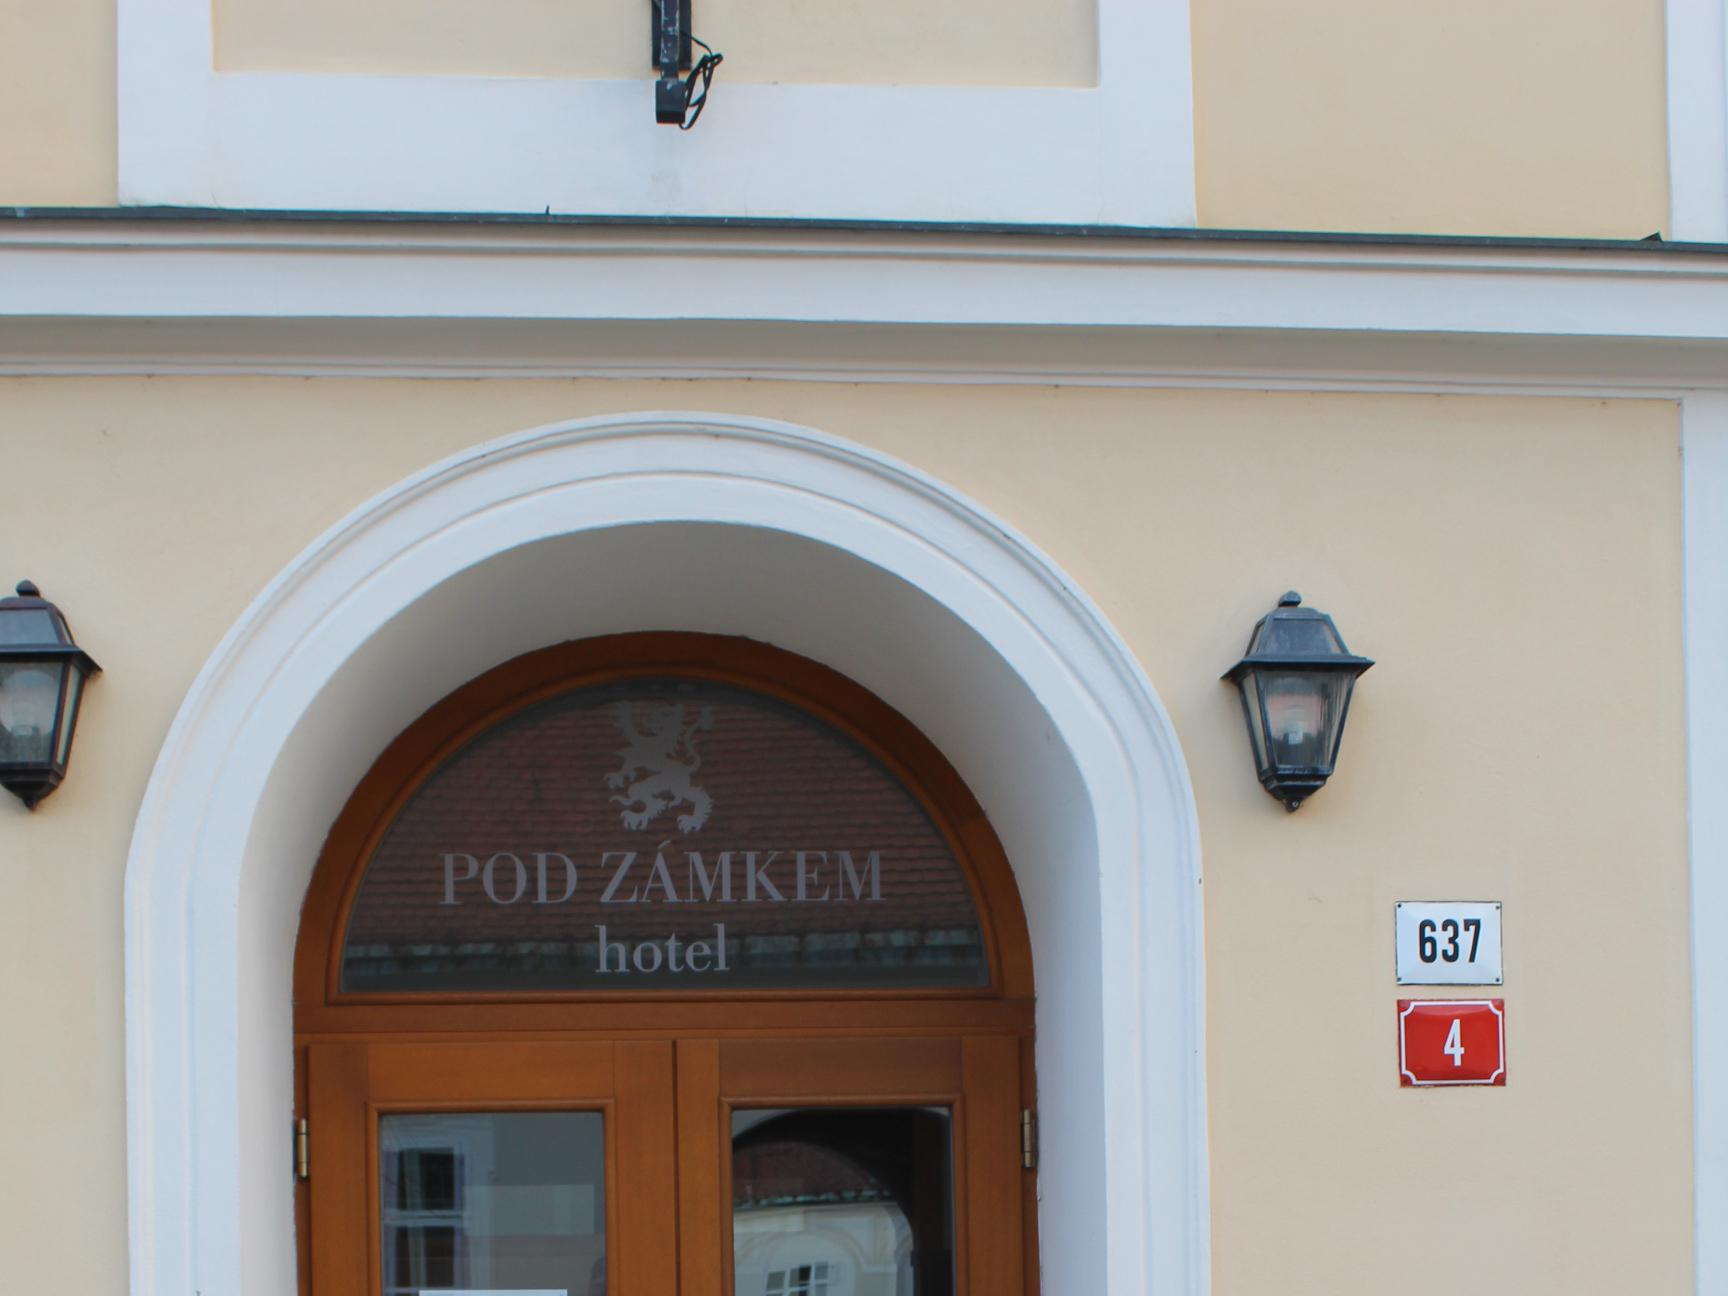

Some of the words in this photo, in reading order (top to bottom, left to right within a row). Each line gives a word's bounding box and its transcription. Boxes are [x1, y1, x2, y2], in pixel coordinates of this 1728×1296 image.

[439, 852, 578, 905] POD
[600, 839, 882, 903] ZÁMKEM
[594, 922, 731, 973] hotel
[1418, 918, 1481, 963] 637
[1443, 1018, 1465, 1067] 4
